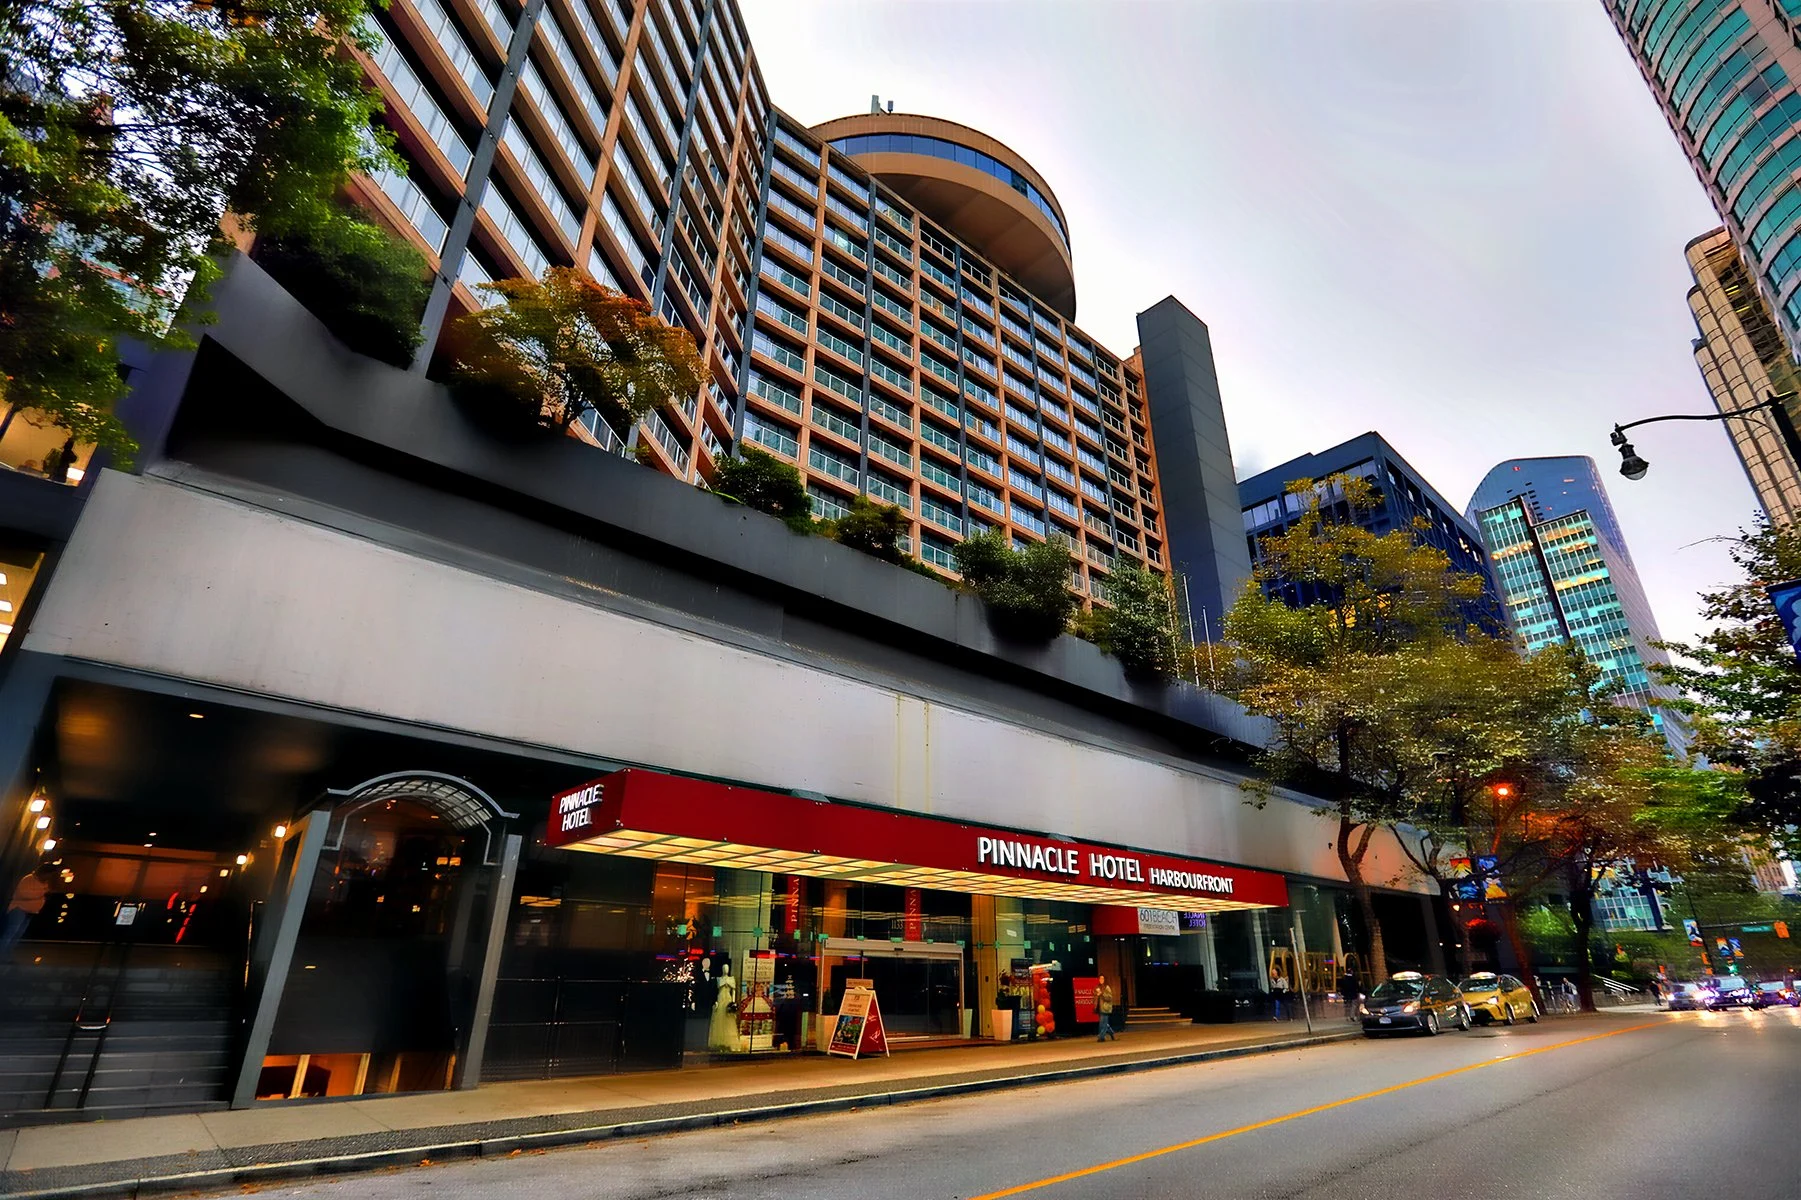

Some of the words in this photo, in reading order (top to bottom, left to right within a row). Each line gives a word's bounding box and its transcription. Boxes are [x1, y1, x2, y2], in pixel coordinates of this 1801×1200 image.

[559, 784, 604, 814] PINNACLE
[562, 807, 592, 831] HOTEL
[978, 837, 1079, 874] PINNACLE
[1089, 853, 1145, 882] HOTEL
[1149, 867, 1233, 893] HARBOURFRONT
